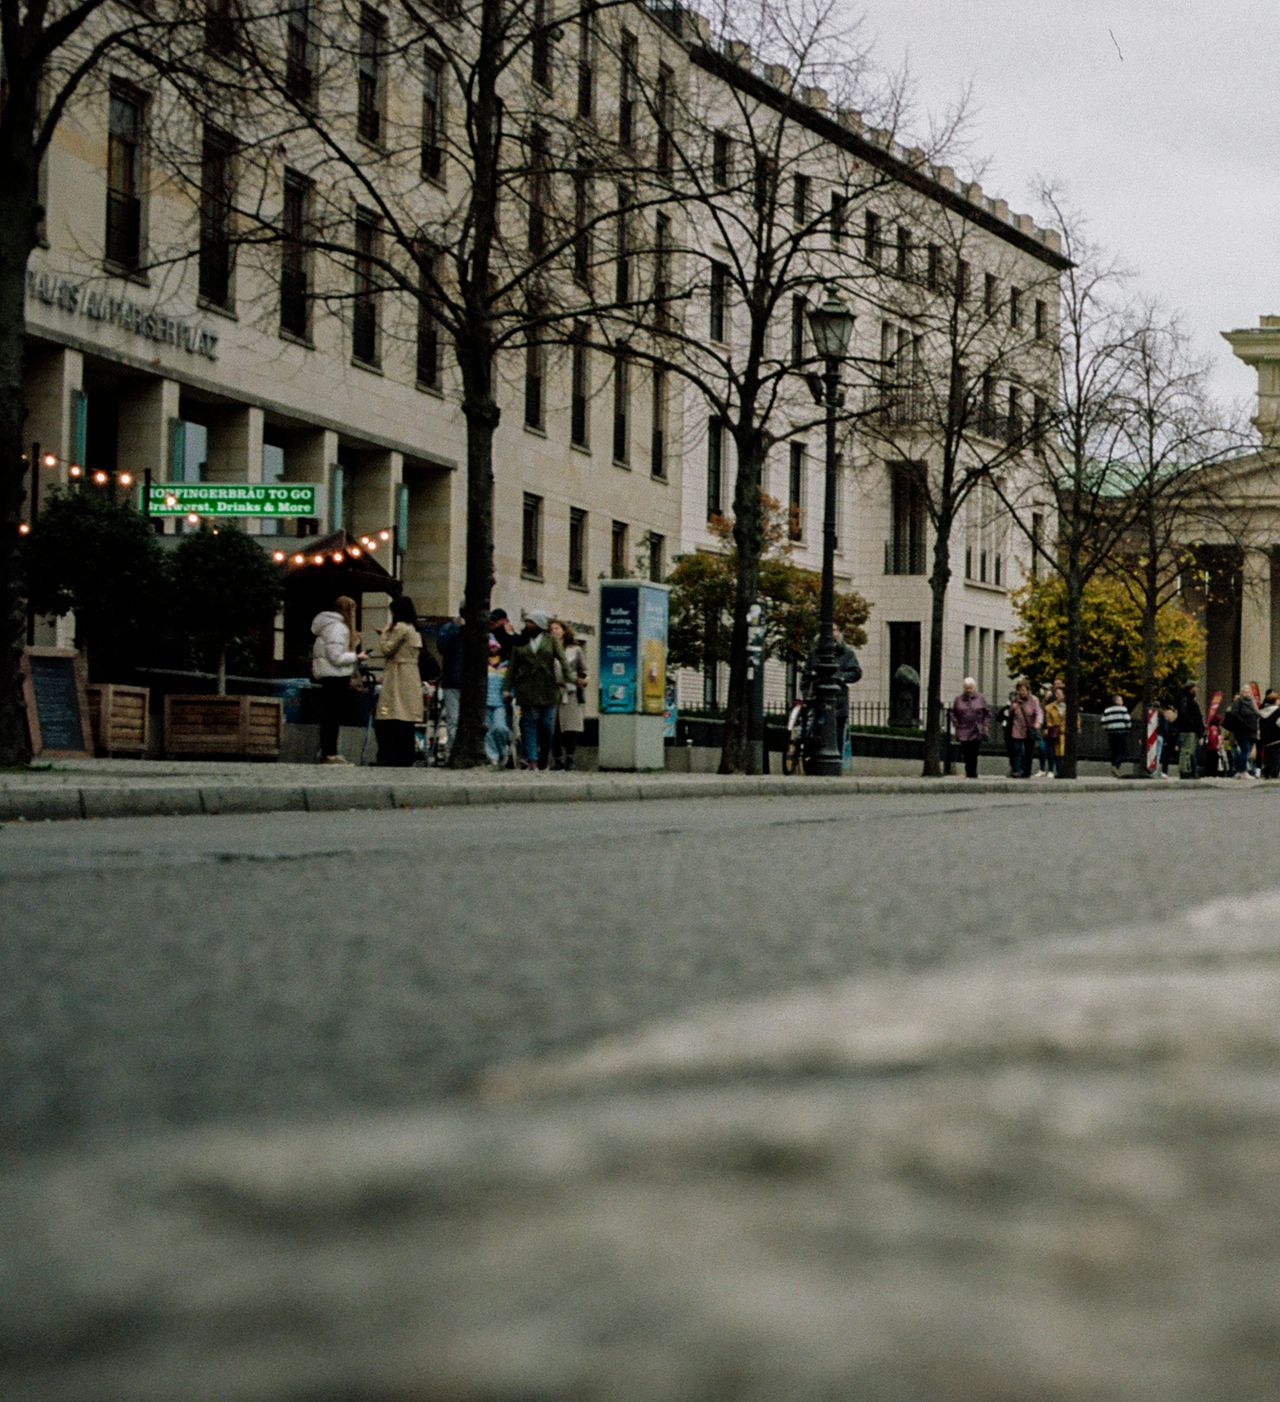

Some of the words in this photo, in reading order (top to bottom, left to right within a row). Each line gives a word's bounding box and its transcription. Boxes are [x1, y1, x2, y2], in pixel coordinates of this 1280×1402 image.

[269, 489, 287, 499] TO
[290, 489, 311, 499] GO
[217, 501, 261, 512] Drinks
[263, 502, 275, 512] &
[278, 502, 311, 512] More
